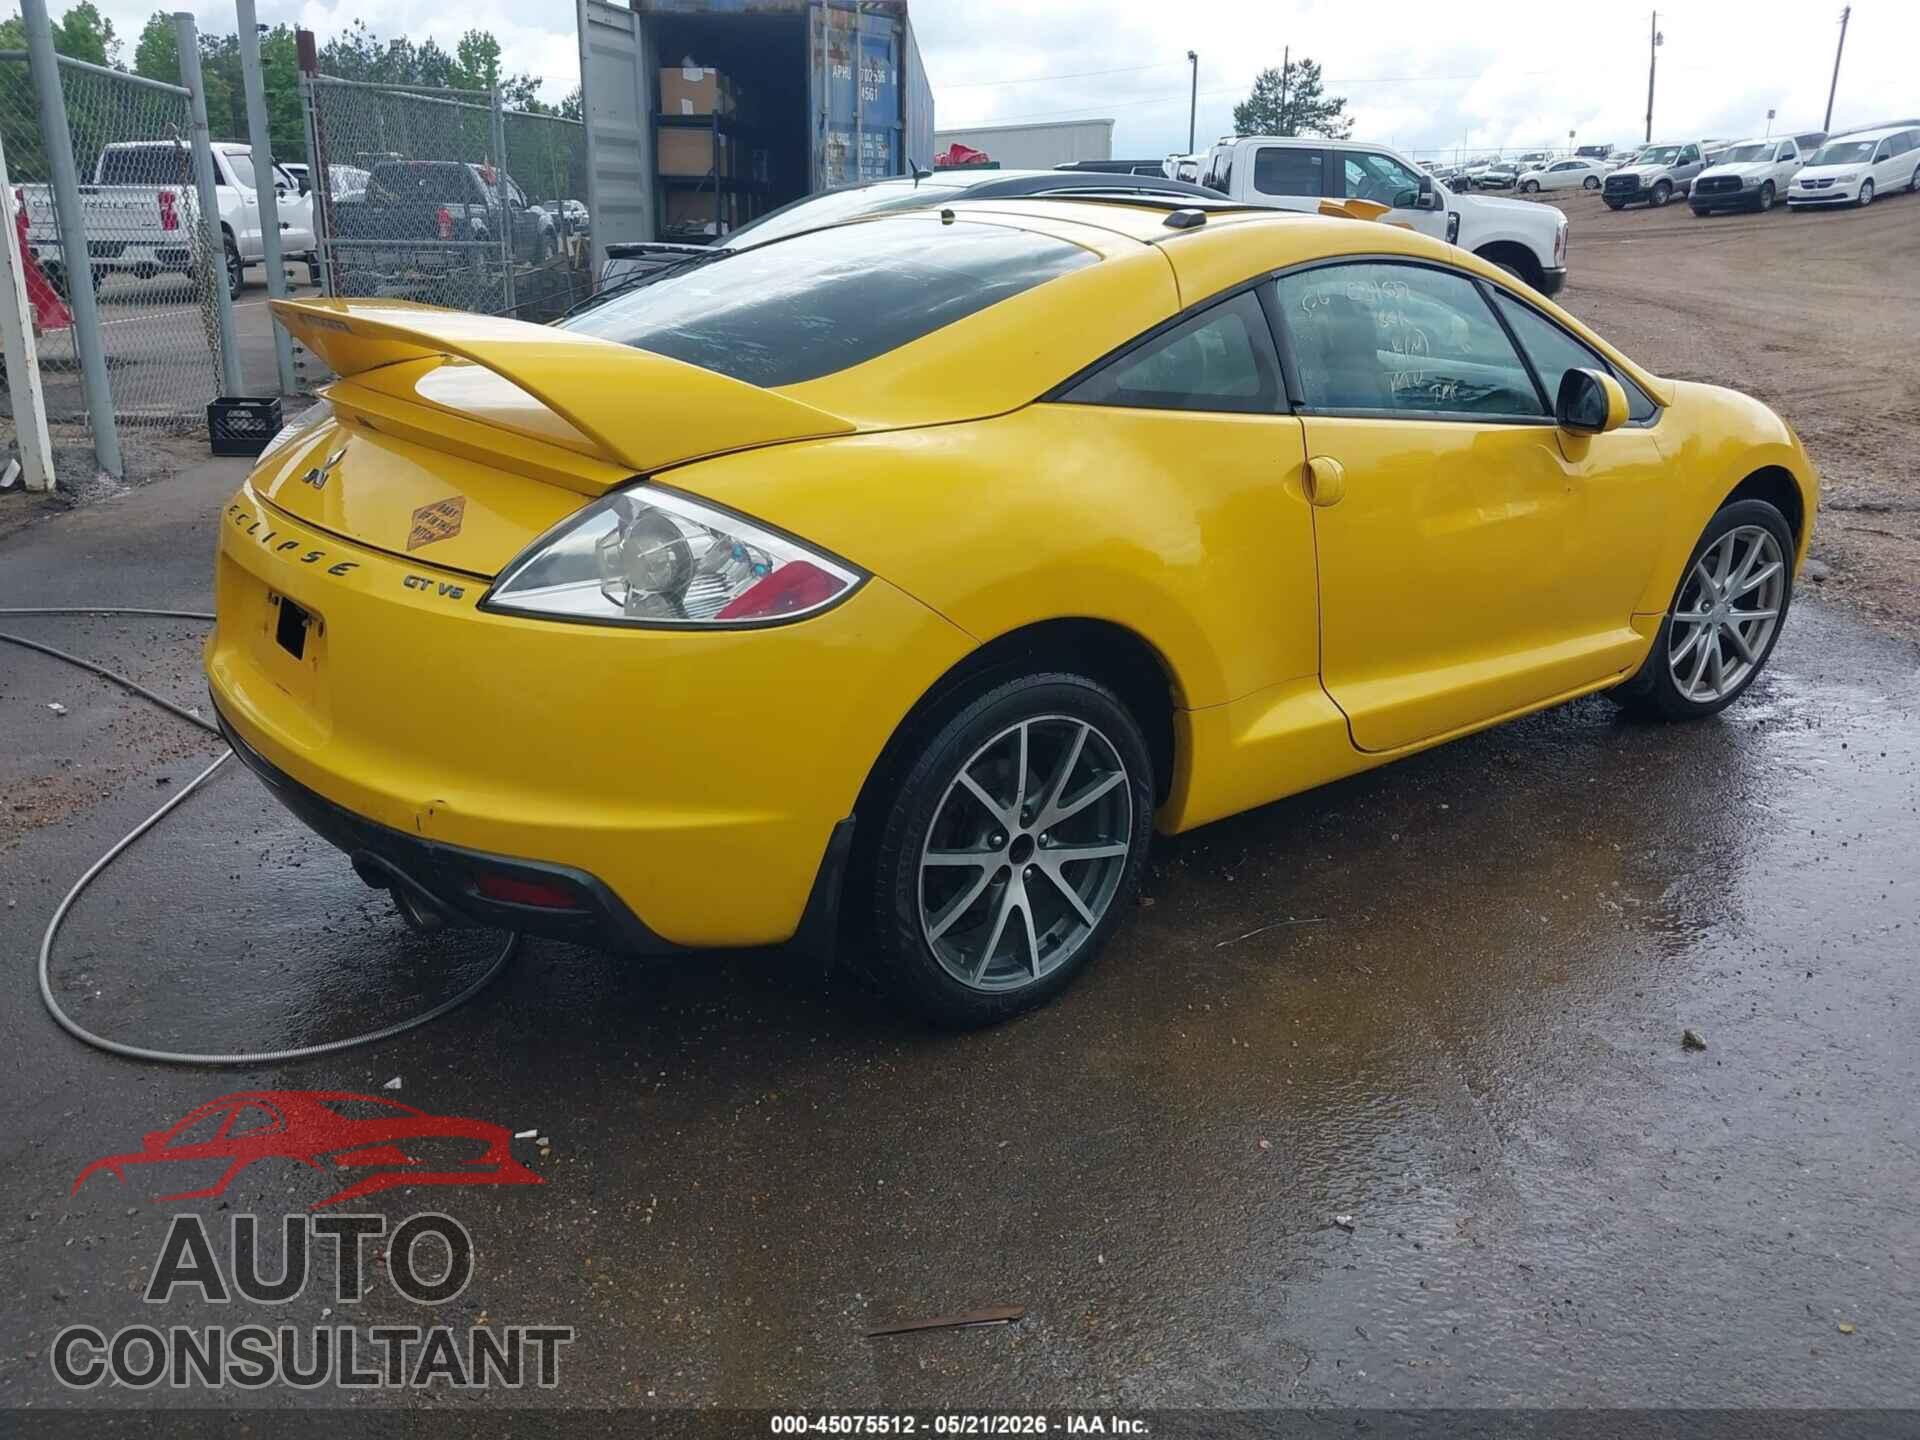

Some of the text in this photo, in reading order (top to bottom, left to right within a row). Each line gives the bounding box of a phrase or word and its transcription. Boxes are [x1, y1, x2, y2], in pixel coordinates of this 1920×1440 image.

[228, 504, 361, 577] ECLIPSE
[403, 574, 466, 600] GT V6
